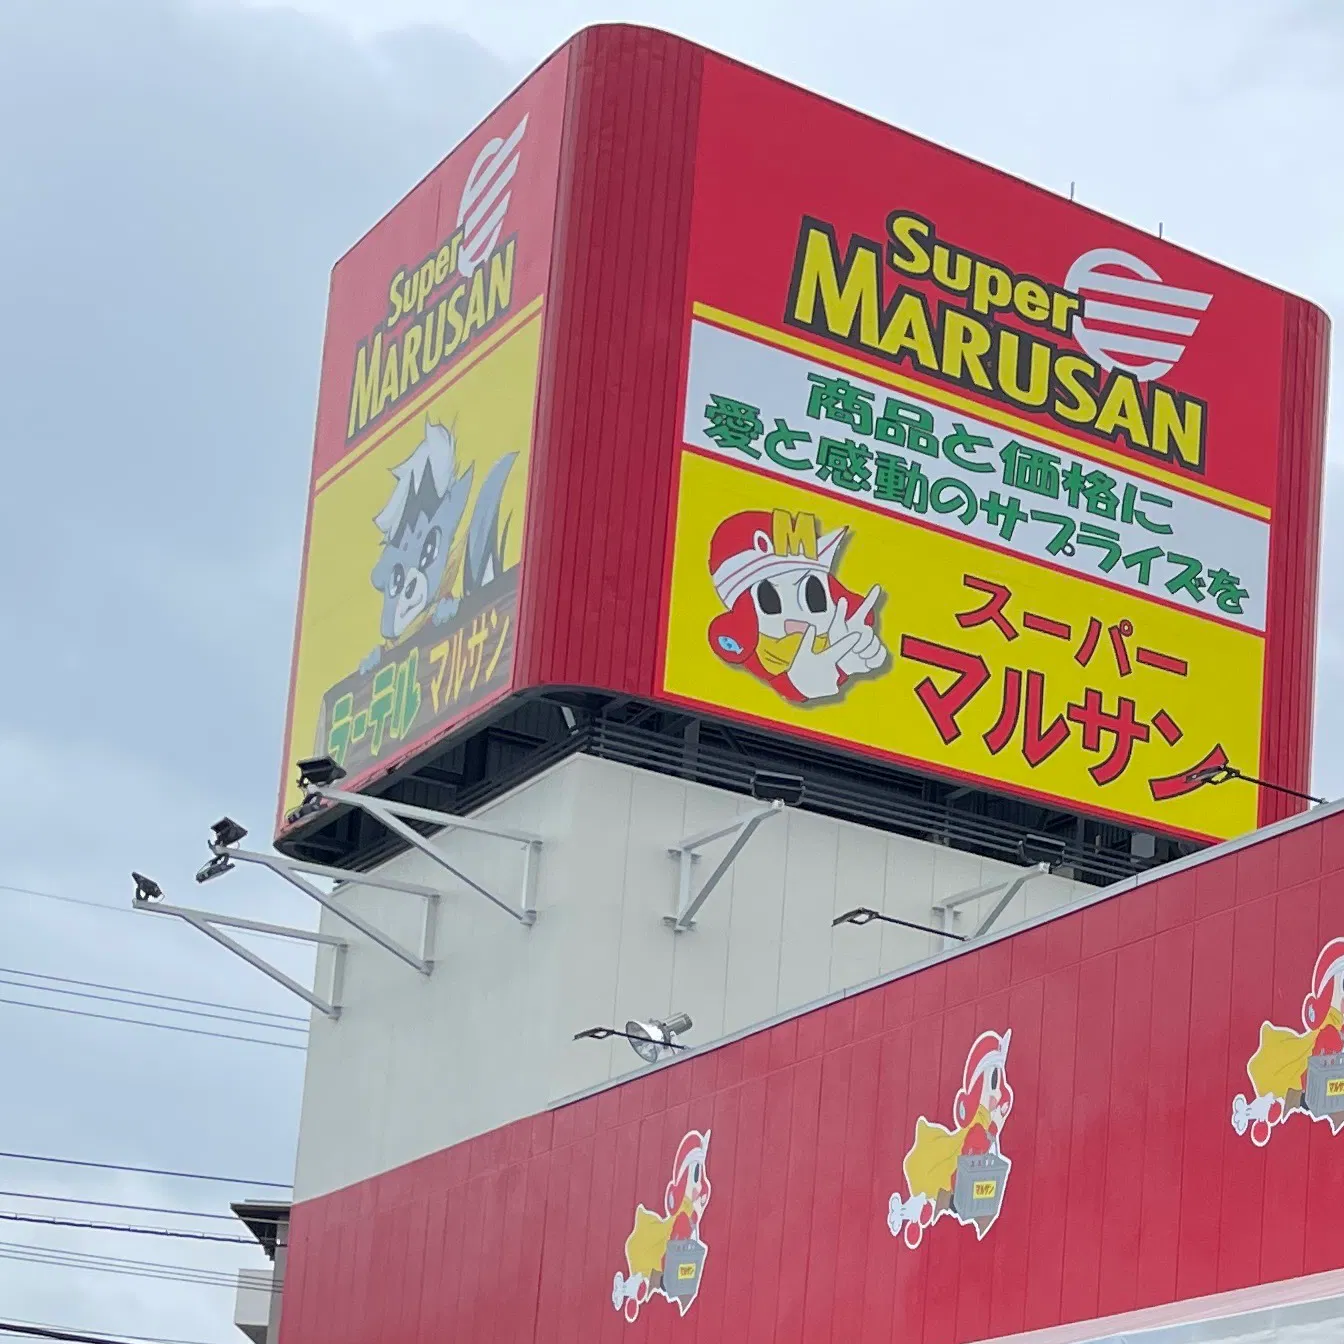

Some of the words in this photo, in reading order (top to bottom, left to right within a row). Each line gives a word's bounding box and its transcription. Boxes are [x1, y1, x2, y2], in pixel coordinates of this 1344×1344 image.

[346, 238, 517, 440] MARUSAN
[386, 230, 465, 328] Super
[792, 226, 1205, 468] MARUSAN
[890, 214, 1080, 333] Super
[703, 392, 1251, 616] 愛と感動のサプライズを
[806, 371, 1176, 537] 商品と価格に
[429, 607, 511, 716] マルサン
[954, 573, 1189, 678] スーパー
[900, 632, 1230, 801] マルサン
